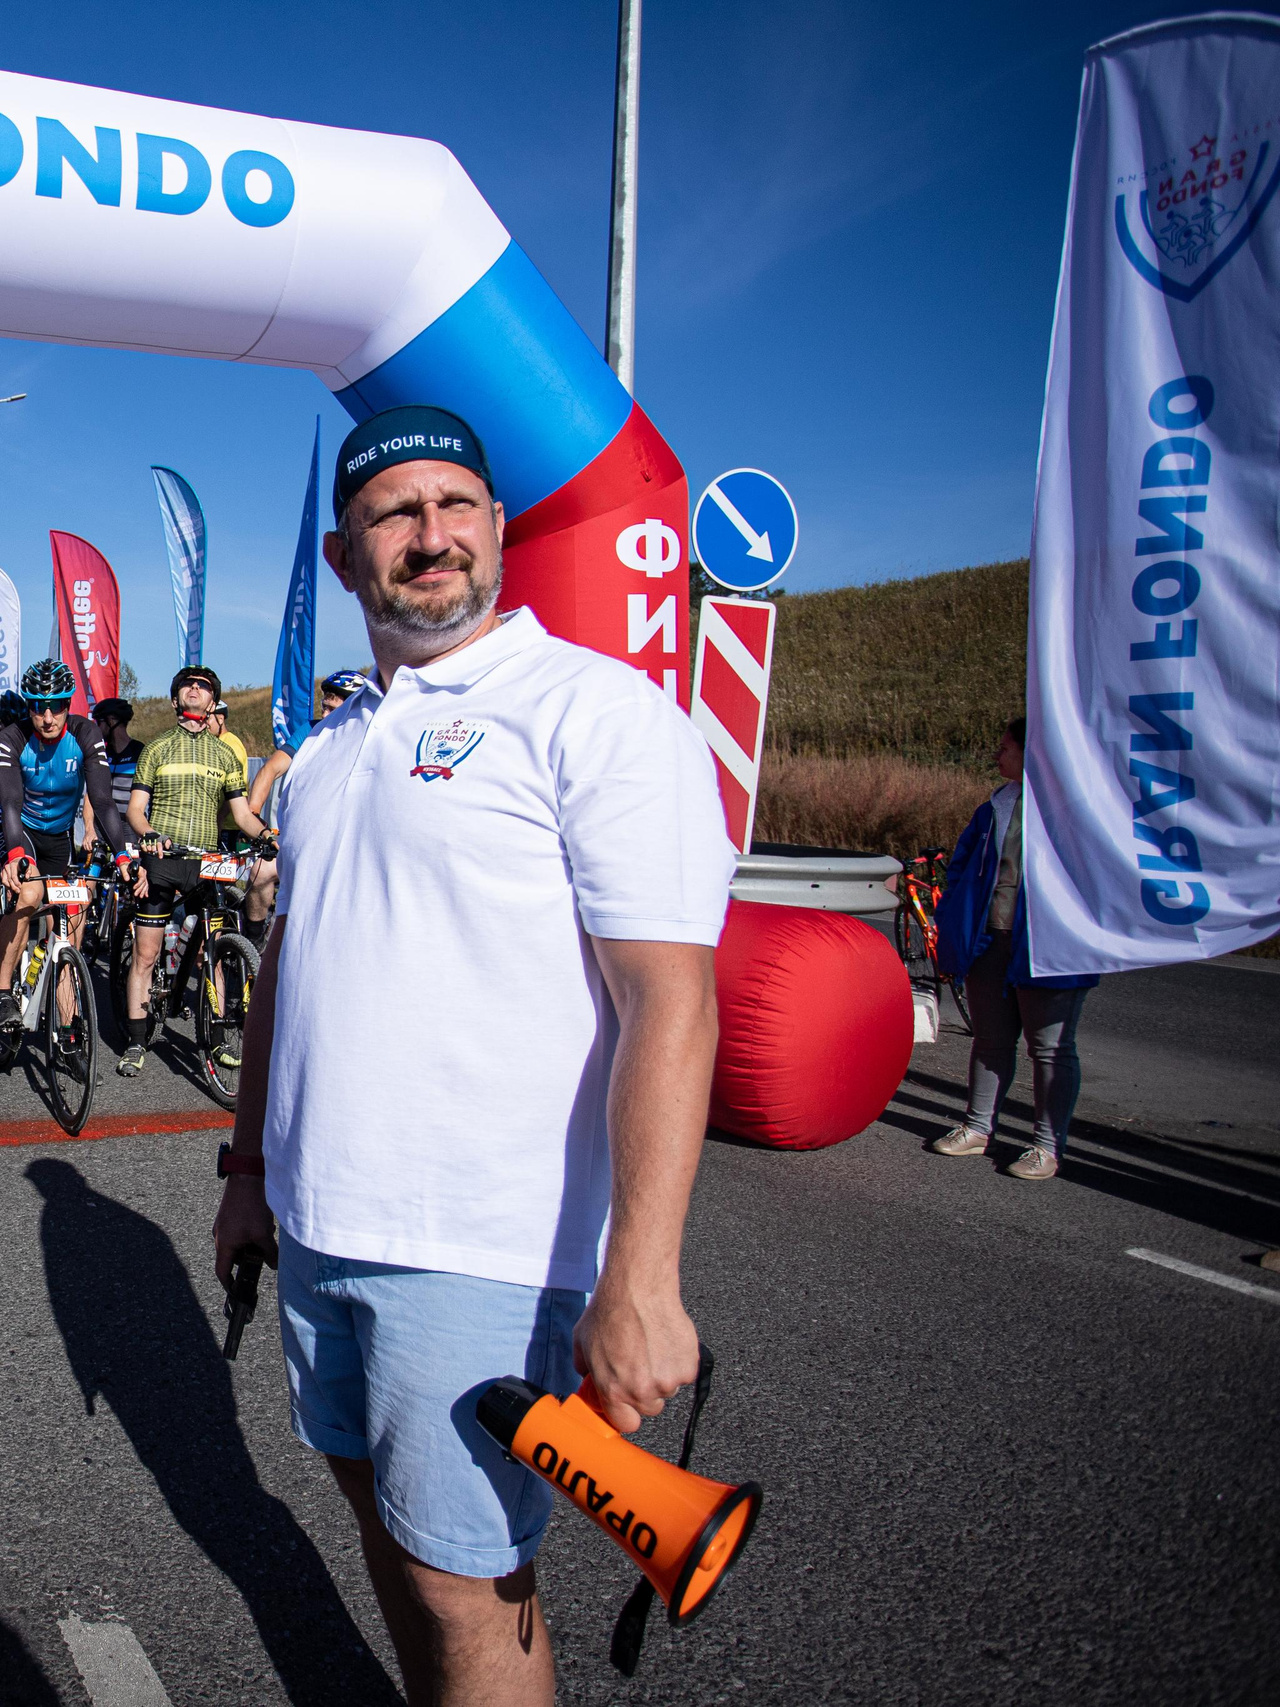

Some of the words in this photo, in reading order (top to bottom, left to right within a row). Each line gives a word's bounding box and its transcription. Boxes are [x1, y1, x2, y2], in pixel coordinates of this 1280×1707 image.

[347, 446, 378, 474] RIDE
[380, 435, 426, 454] YOUR
[429, 435, 463, 452] LIFE
[206, 864, 232, 876] 2003
[56, 889, 81, 899] 2011
[532, 1442, 658, 1559] ОРАЛО
